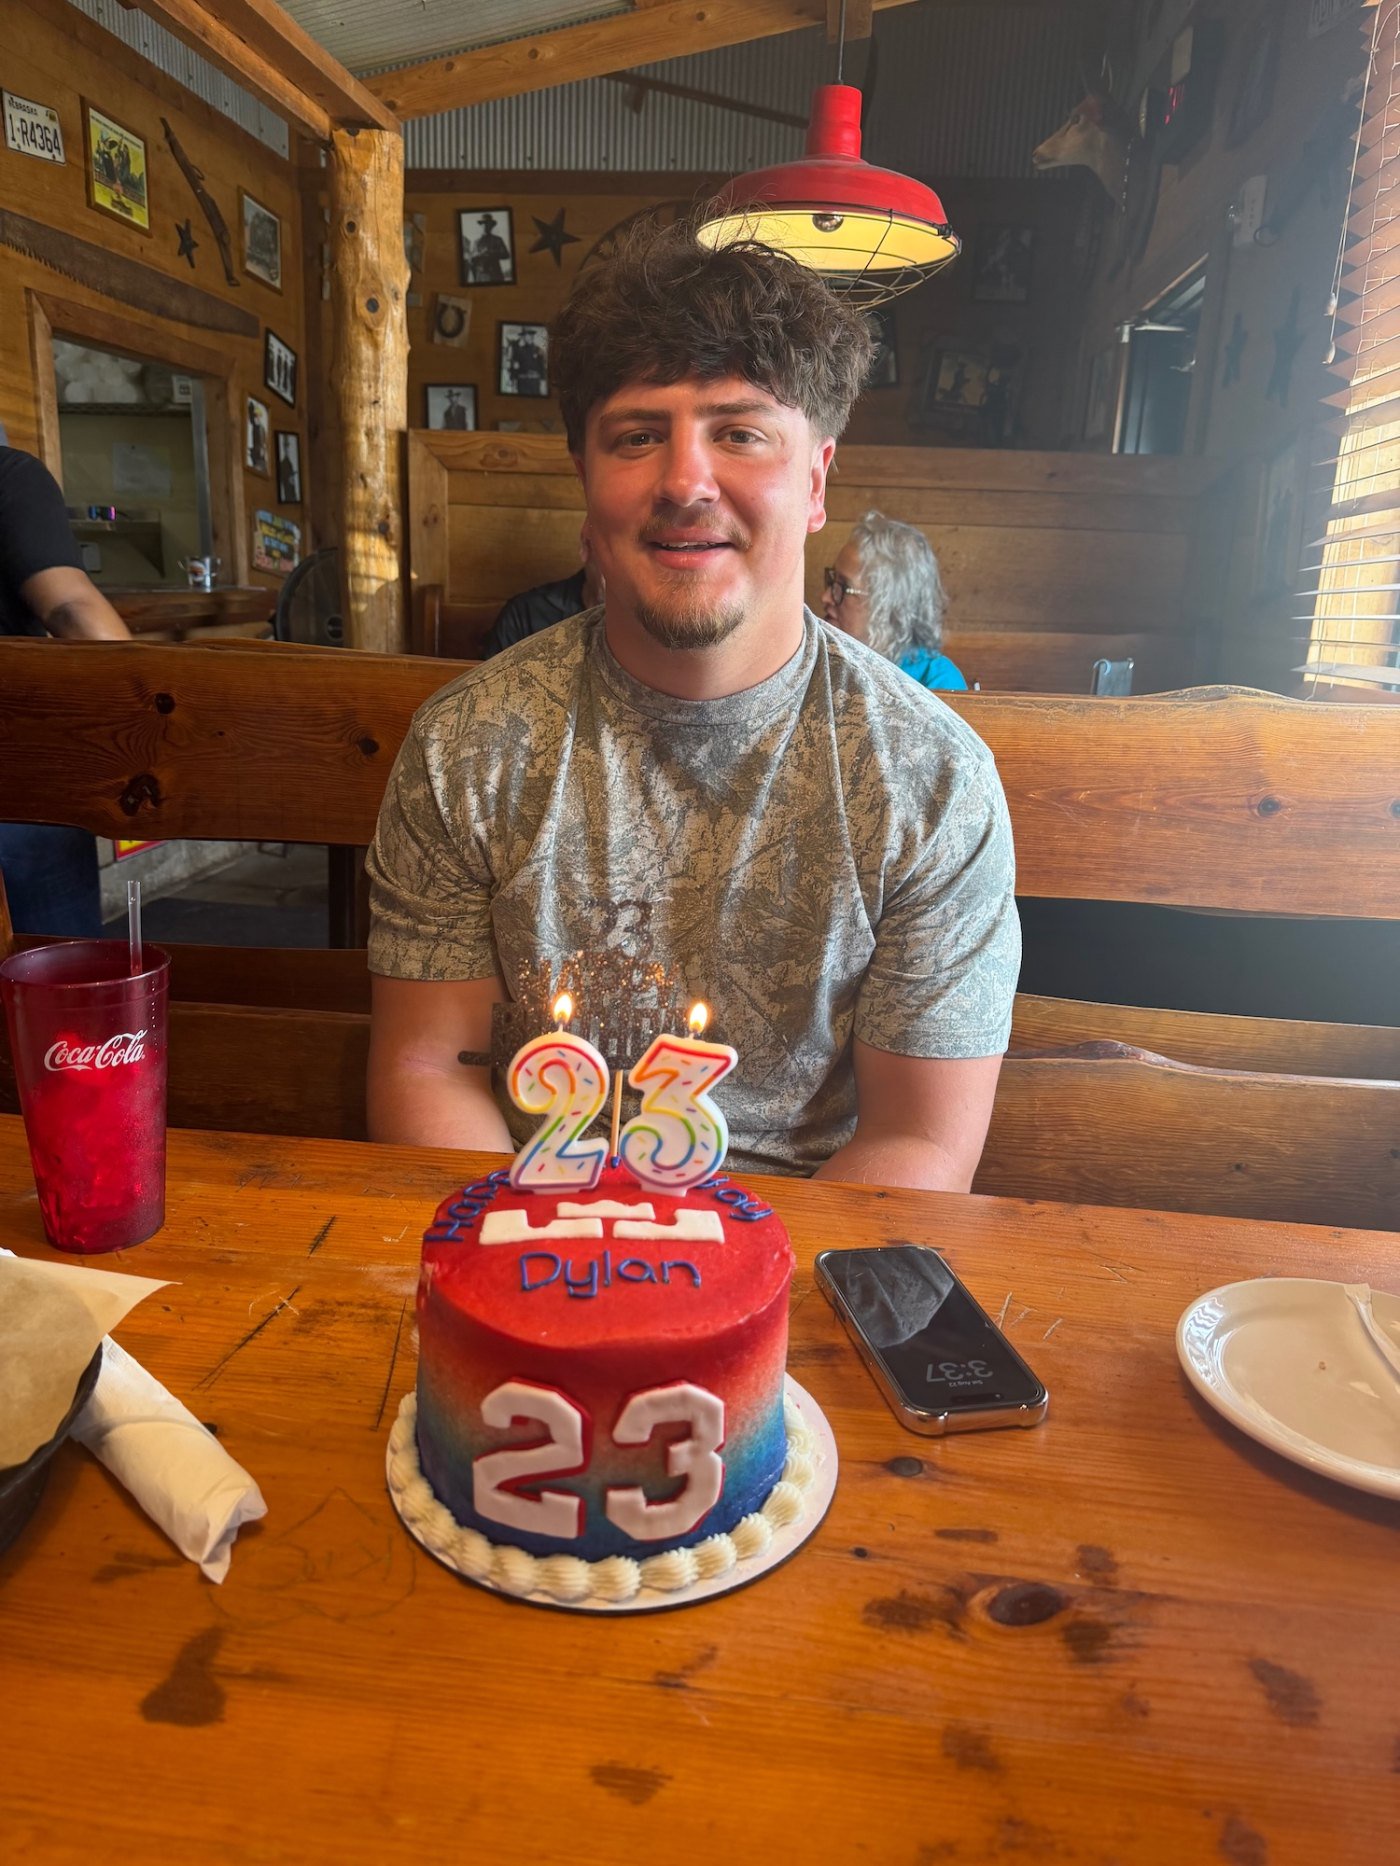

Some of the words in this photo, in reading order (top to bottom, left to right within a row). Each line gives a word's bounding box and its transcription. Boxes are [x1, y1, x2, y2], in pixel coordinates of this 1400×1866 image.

[44, 1029, 147, 1071] Coca-Cola
[518, 1250, 702, 1298] Dylan
[927, 1360, 993, 1382] 3:37
[472, 1377, 725, 1541] 23
